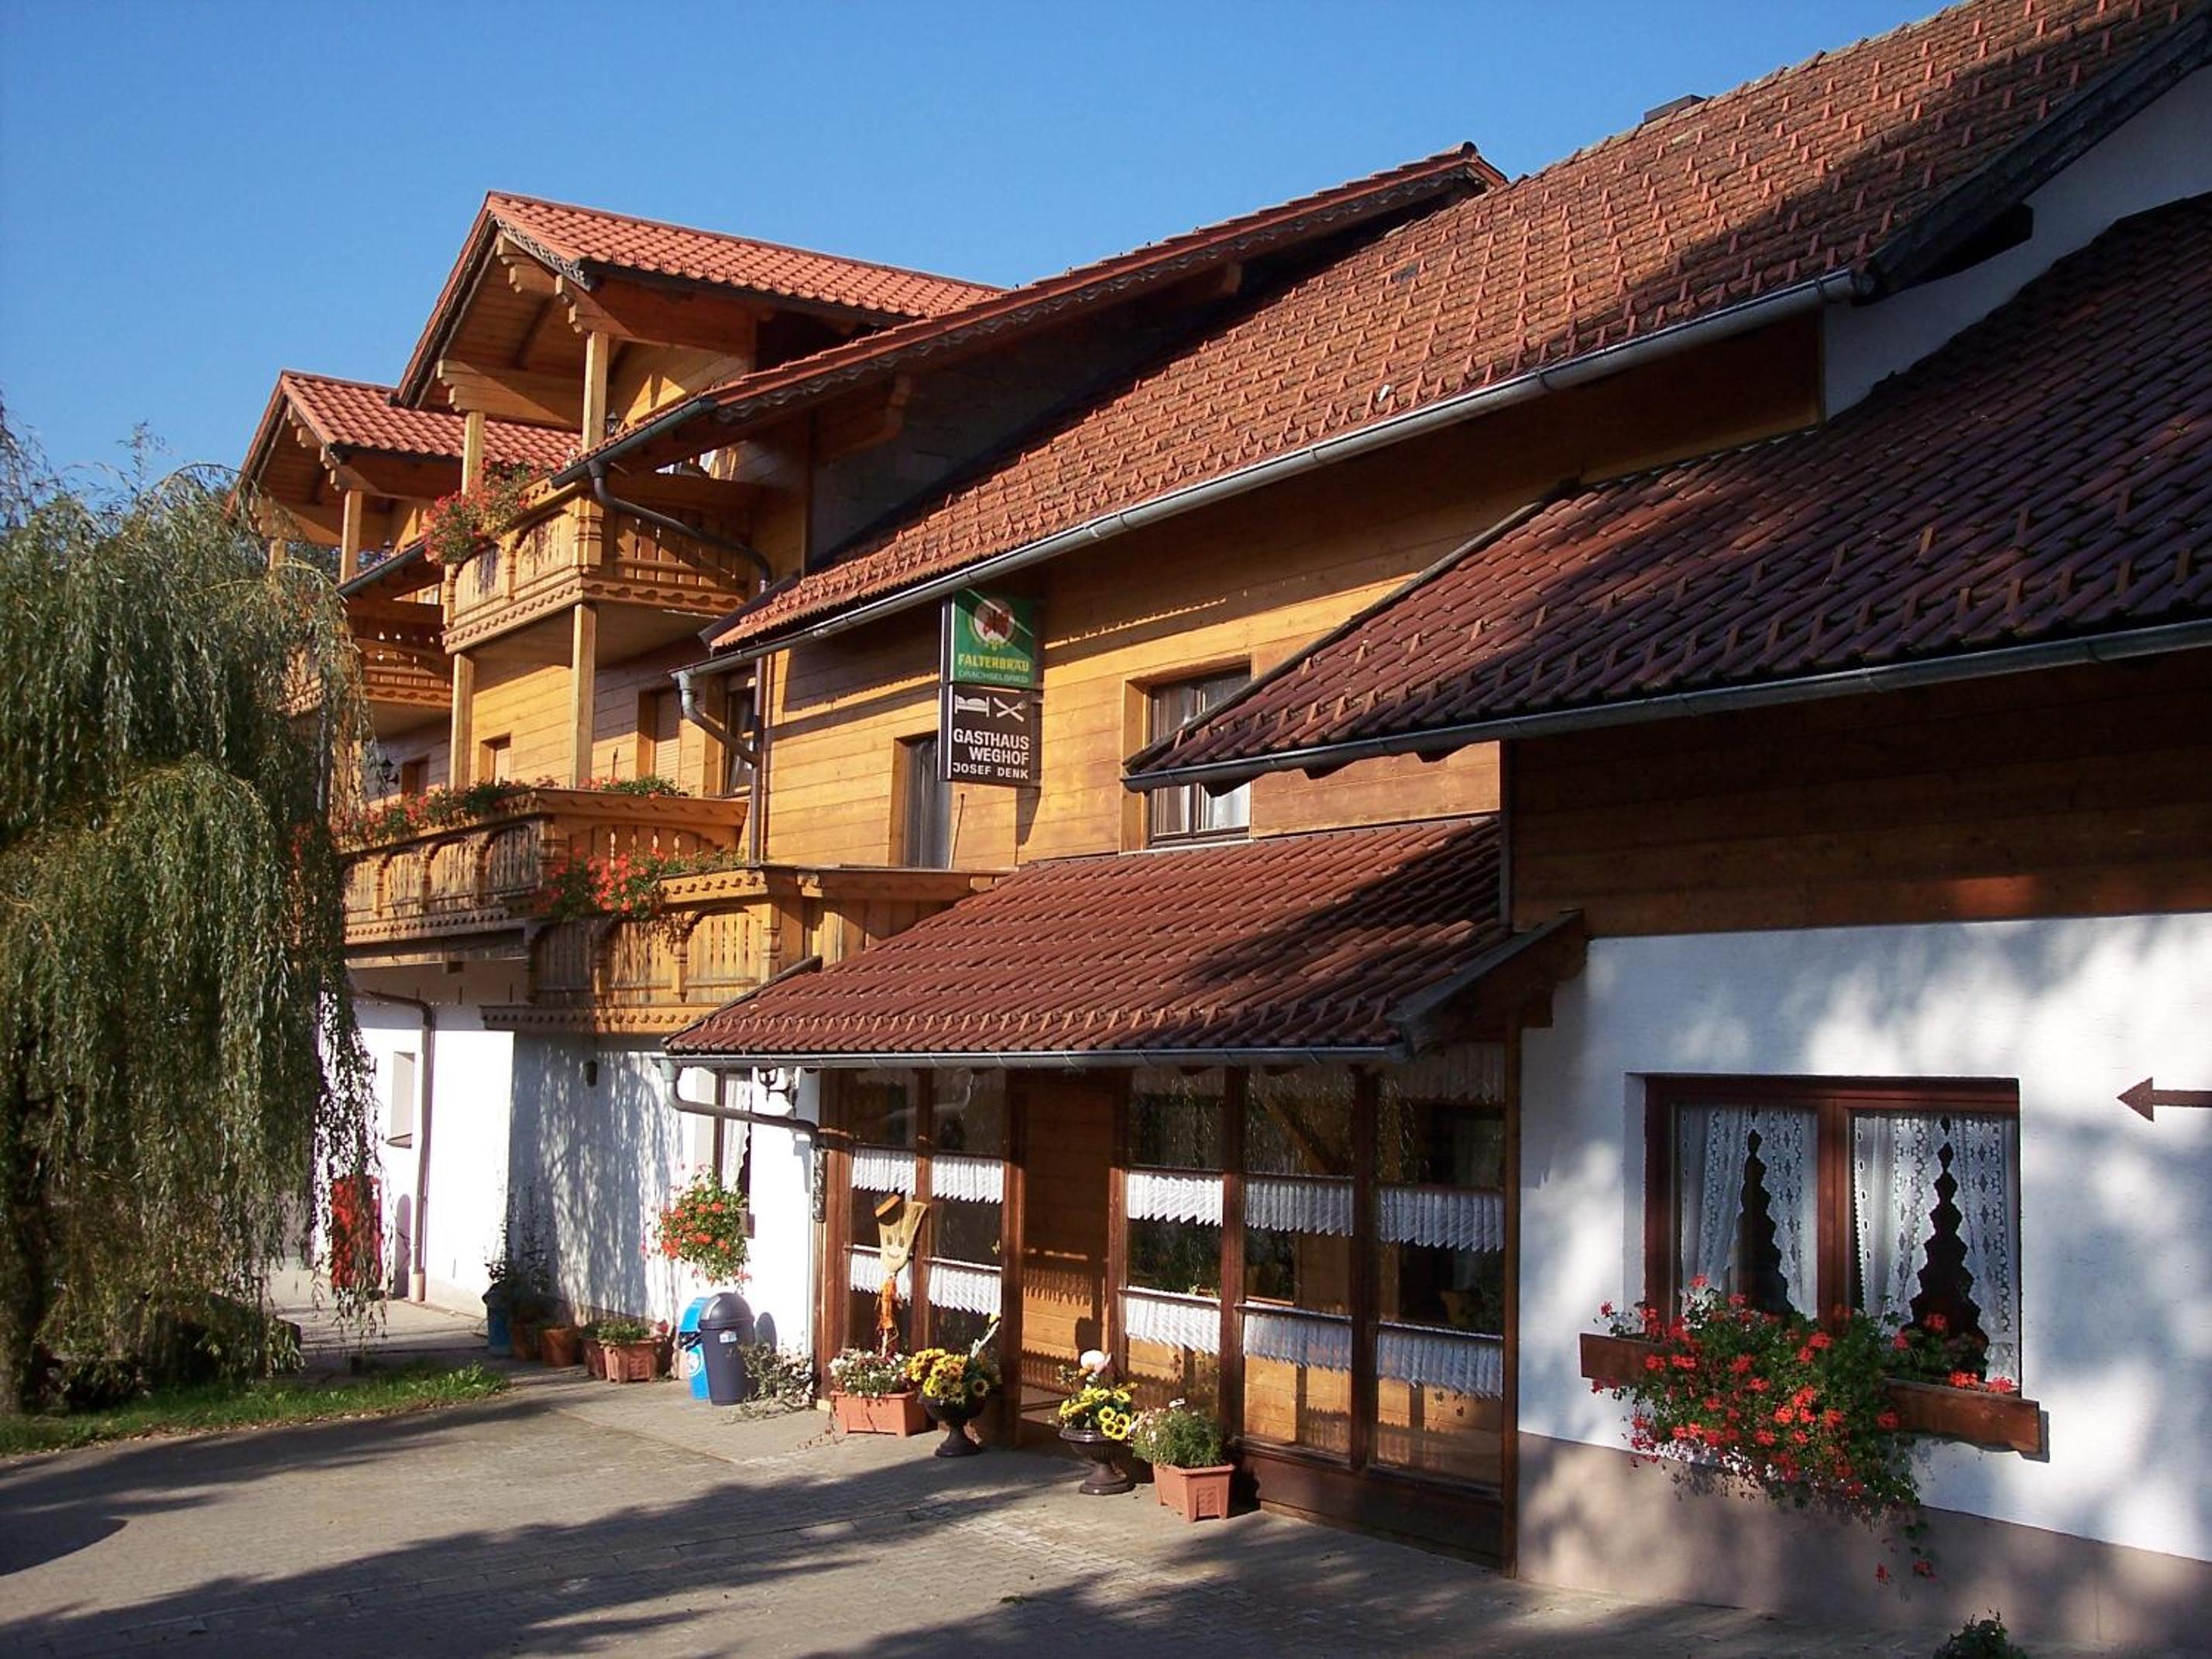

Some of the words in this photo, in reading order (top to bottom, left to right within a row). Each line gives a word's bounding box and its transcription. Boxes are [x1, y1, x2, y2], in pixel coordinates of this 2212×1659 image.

[953, 729, 1029, 750] GASTHAUS
[969, 747, 1029, 765] WEGHOF
[953, 762, 991, 775] JOSEF
[997, 767, 1029, 779] DENK
